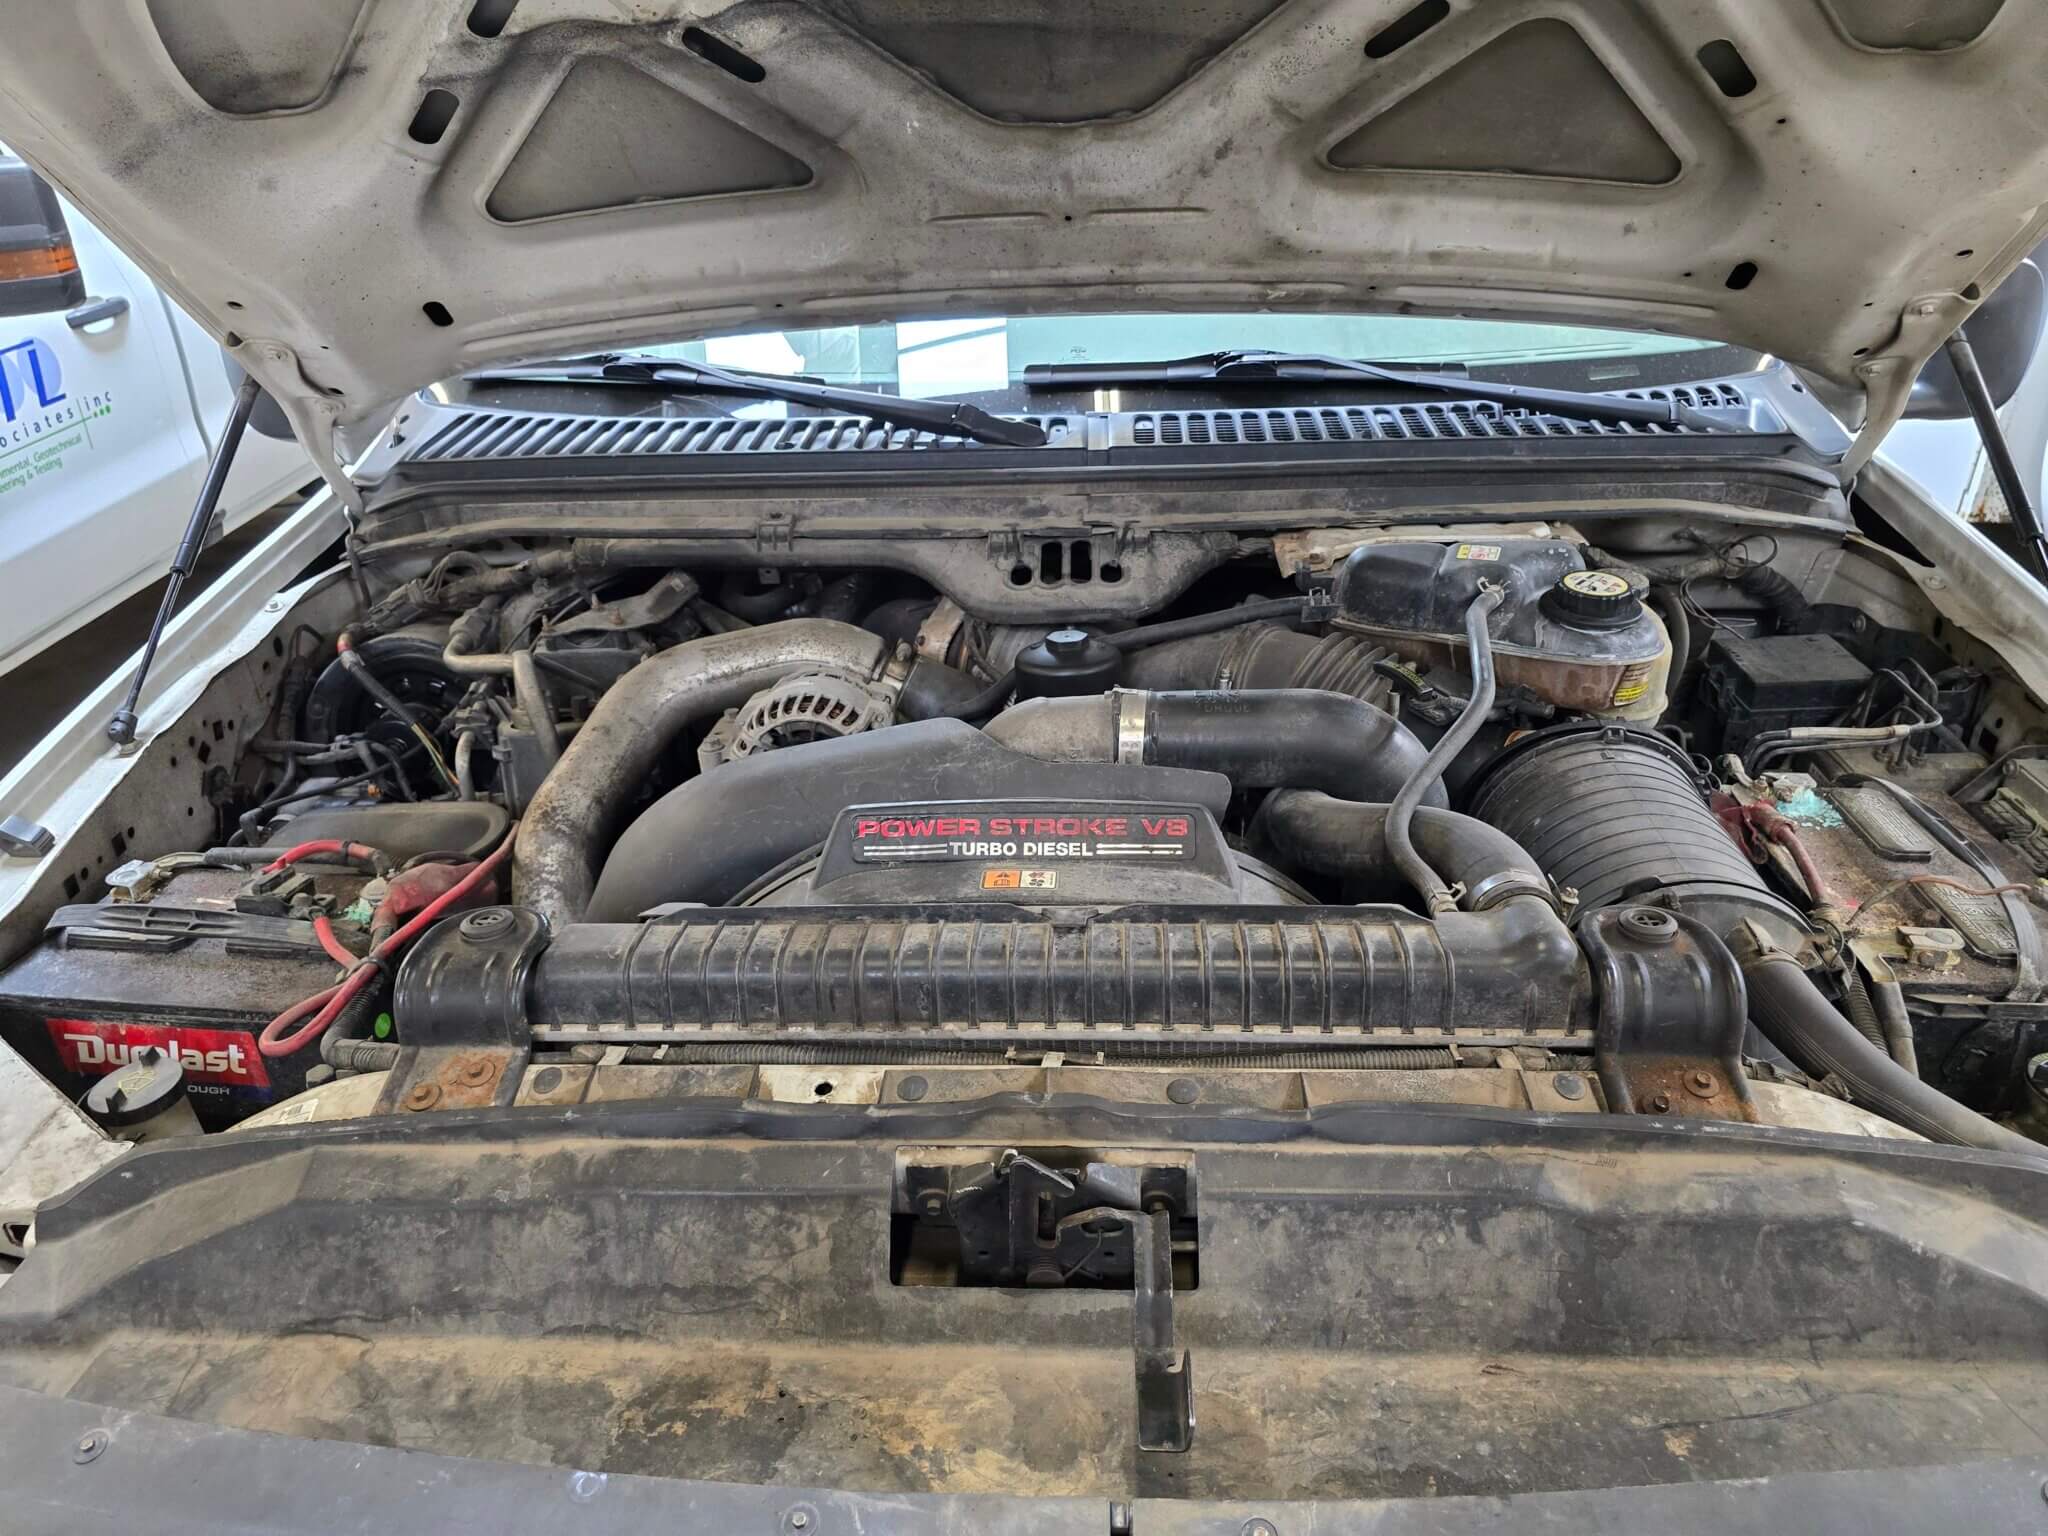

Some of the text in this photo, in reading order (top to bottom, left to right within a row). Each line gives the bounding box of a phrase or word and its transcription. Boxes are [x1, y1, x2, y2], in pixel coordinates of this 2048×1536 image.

[84, 390, 112, 411] inc
[33, 432, 82, 463] Geotechnical
[34, 457, 63, 475] Testing
[858, 818, 1189, 839] POWER STROKE V8
[949, 841, 1094, 857] TURBO DIESEL
[187, 1084, 231, 1096] OUGH
